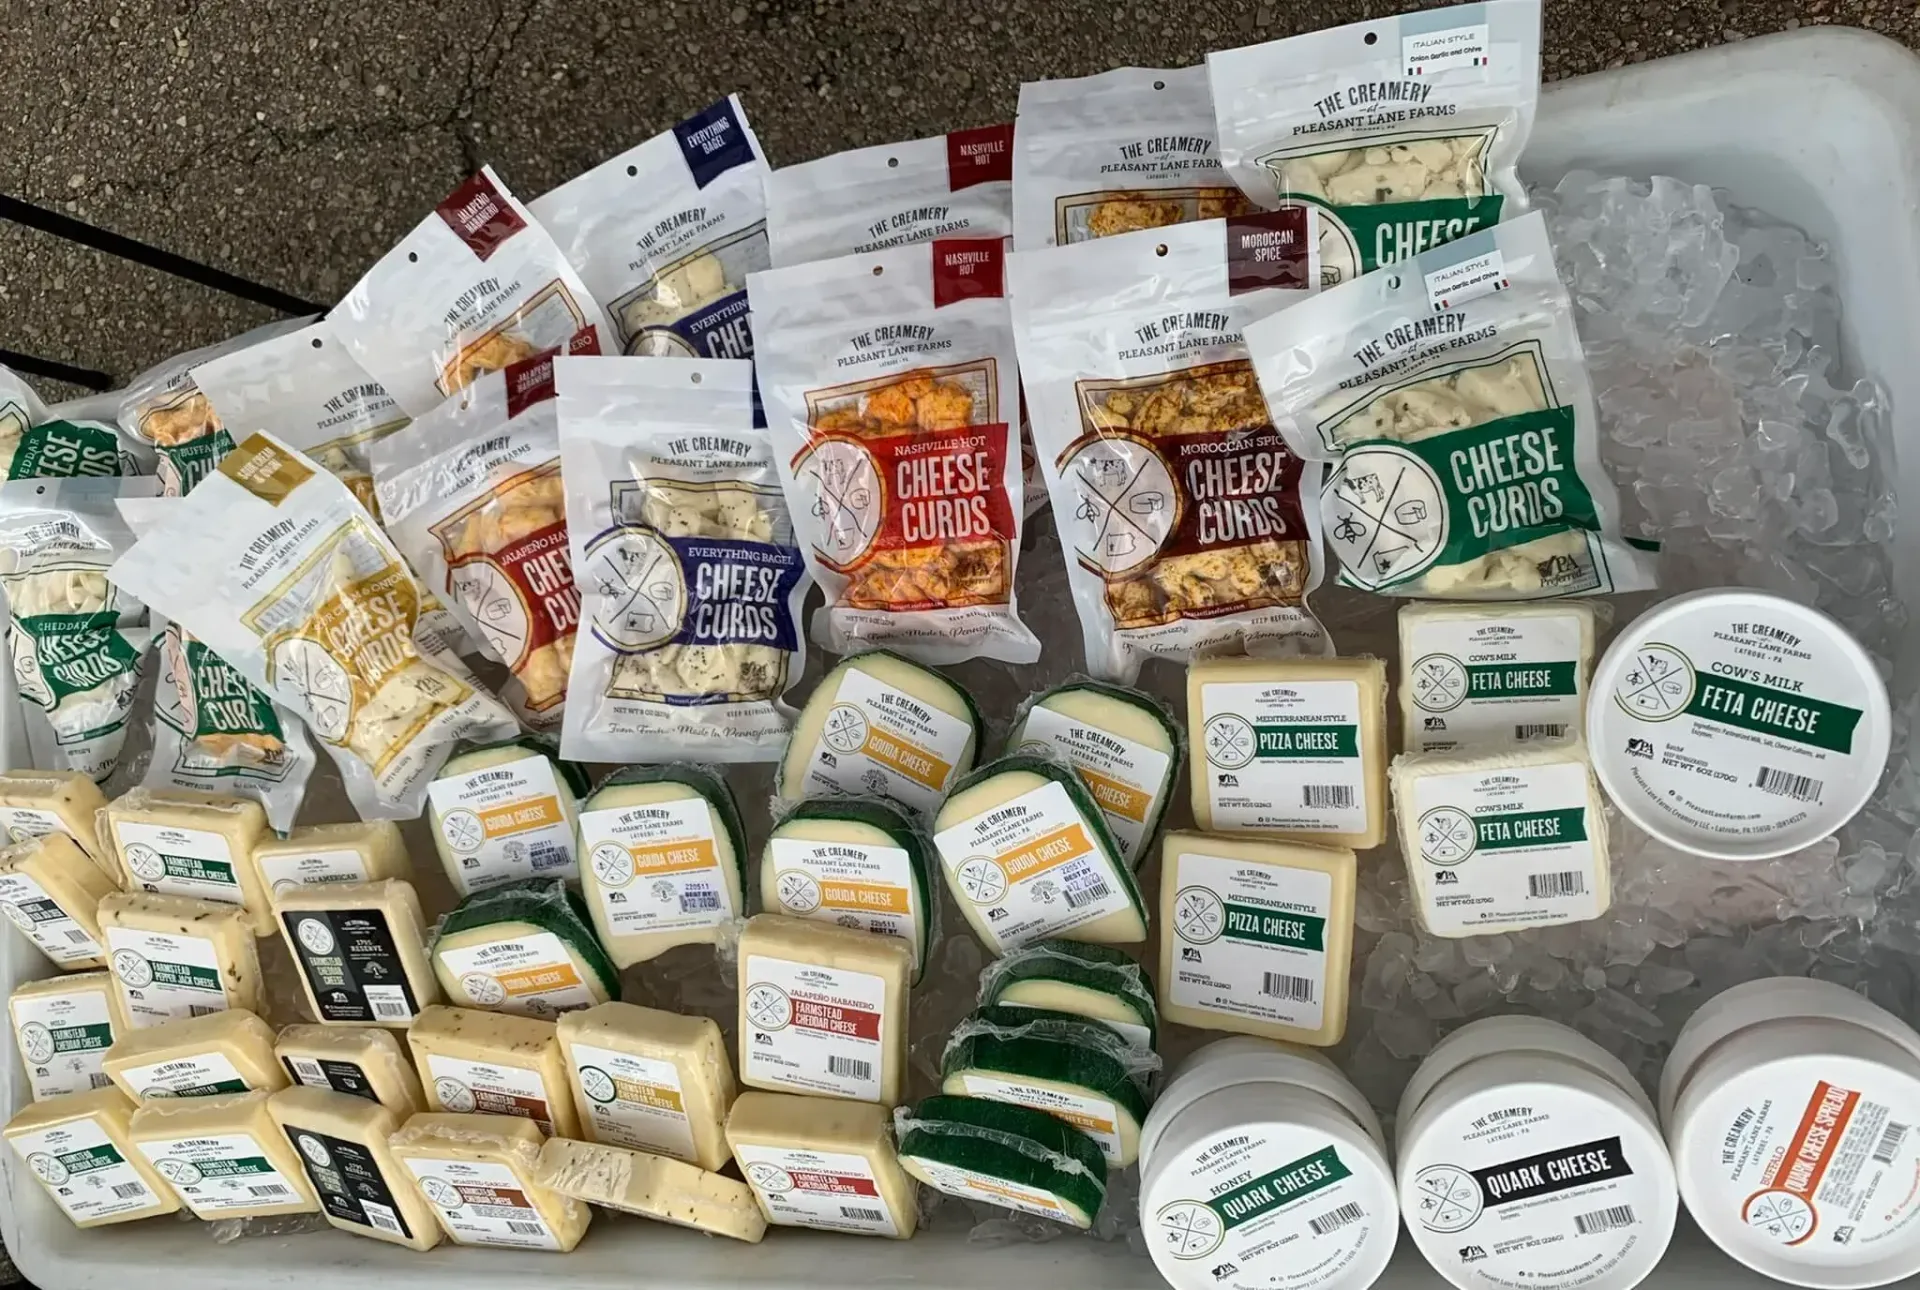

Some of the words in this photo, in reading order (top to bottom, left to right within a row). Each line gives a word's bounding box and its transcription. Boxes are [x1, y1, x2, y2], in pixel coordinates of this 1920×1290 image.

[1412, 36, 1447, 49] ITALIAN
[1448, 32, 1475, 44] STYLE
[1409, 54, 1430, 62] Onion
[1313, 95, 1344, 118] THE
[1348, 81, 1432, 106] CREAMERY
[686, 116, 730, 149] EVERYTHING
[1292, 116, 1364, 136] PLEASANT
[1368, 111, 1406, 126] LANE
[1409, 104, 1456, 120] FARMS
[701, 135, 726, 155] BAGEL
[960, 140, 1005, 156] NASHVILLE
[1120, 144, 1144, 161] THE
[1147, 136, 1212, 156] CREAMERY
[975, 154, 991, 165] HOT
[456, 192, 491, 224] JALAPEÑO
[464, 204, 499, 235] HABANERO
[637, 230, 656, 251] THE
[654, 206, 707, 239] CREAMERY
[869, 219, 888, 239] THE
[890, 206, 949, 229] CREAMERY
[1241, 229, 1294, 249] MOROCCAN
[945, 251, 990, 267] NASHVILLE
[1255, 247, 1281, 262] SPICE
[959, 262, 975, 276] HOT
[1433, 269, 1462, 283] ITALIAN
[1463, 258, 1491, 274] STYLE
[851, 332, 871, 351] THE
[874, 325, 935, 347] CREAMERY
[1134, 323, 1158, 344] THE
[1161, 312, 1229, 334] CREAMERY
[1354, 339, 1383, 369] THE
[1385, 312, 1467, 351] CREAMERY
[838, 351, 886, 368] PLEASANT
[888, 345, 916, 357] LANE
[917, 339, 952, 352] FARMS
[1338, 359, 1409, 391] PLEASANT
[1411, 342, 1448, 367] LANE
[1450, 325, 1497, 350] FARMS
[668, 441, 689, 456] THE
[691, 436, 752, 458] CREAMERY
[894, 438, 959, 456] NASHVILLE
[960, 436, 986, 449] HOT
[1180, 438, 1254, 456] MOROCCAN
[1257, 436, 1284, 448] SPIC
[1450, 427, 1564, 494] CHEESE
[897, 451, 991, 500] CHEESE
[1186, 451, 1283, 501] CHEESE
[901, 494, 991, 544] CURDS
[1199, 496, 1288, 544] CURDS
[1468, 478, 1564, 539] CURDS
[240, 553, 254, 570] THE
[250, 518, 297, 555] CREAMERY
[501, 531, 549, 567] JALAPEÑO
[688, 547, 760, 562] EVERYTHING
[761, 554, 794, 566] BAGEL
[696, 562, 785, 604] CHEESE
[38, 622, 89, 631] CHEDDAR
[699, 601, 778, 642] CURDS
[1732, 623, 1749, 634] THE
[1752, 624, 1801, 648] CREAMERY
[53, 645, 123, 687] CURDS
[1469, 653, 1495, 662] COW'S
[1496, 653, 1517, 661] MILK
[1472, 672, 1501, 690] FETA
[1506, 670, 1552, 689] CHEESE
[1712, 661, 1760, 682] COW'S
[1764, 673, 1804, 692] MILK
[866, 699, 899, 720] PLEASANT
[898, 714, 917, 727] LANE
[915, 722, 938, 737] FARMS
[880, 693, 895, 704] THE
[896, 696, 932, 723] CREAMERY
[1256, 715, 1322, 723] MEDITERRANEAN
[1701, 684, 1743, 716] FETA
[1750, 697, 1821, 734] CHEESE
[1070, 728, 1085, 739] THE
[1086, 732, 1127, 756] CREAMERY
[1260, 733, 1292, 750] PIZZA
[1295, 733, 1339, 750] CHEESE
[869, 735, 899, 761] GOUDA
[900, 752, 934, 778] CHEESE
[1662, 757, 1680, 769] NET
[1680, 761, 1694, 772] WT
[1096, 784, 1131, 809] CHEESE
[1475, 804, 1502, 813] COW'S
[619, 815, 632, 825] THE
[634, 808, 670, 820] CREAMERY
[974, 820, 991, 834] THE
[987, 806, 1027, 830] CREAMERY
[969, 828, 1004, 848] PLEASANT
[1004, 821, 1024, 834] LANE
[1022, 811, 1044, 825] FARMS
[1480, 822, 1511, 842] FETA
[1514, 817, 1561, 838] CHEESE
[164, 855, 203, 870] FARMSTEAD
[636, 852, 666, 868] GOUDA
[668, 848, 700, 864] CHEESE
[813, 848, 827, 858] THE
[828, 847, 868, 861] CREAMERY
[1004, 853, 1038, 875] GOUDA
[1038, 838, 1073, 862] CHEESE
[167, 865, 191, 878] PEPPER
[191, 868, 207, 879] JACK
[206, 869, 229, 882] CHEESE
[318, 873, 358, 883] AMERICAN
[1064, 872, 1080, 882] BEST
[1082, 867, 1091, 875] BY
[825, 888, 856, 902] GOUDA
[858, 890, 892, 906] CHEESE
[1228, 894, 1293, 910] MEDITERRANEAN
[1293, 905, 1317, 913] STYLE
[1228, 912, 1259, 933] PIZZA
[1263, 918, 1306, 940] CHEESE
[791, 990, 830, 1003] JALAPEÑO
[831, 997, 874, 1010] HABANERO
[795, 1002, 843, 1020] FARMSTEAD
[52, 1028, 86, 1039] FARMSTEAD
[795, 1014, 830, 1031] CHEDDAR
[830, 1019, 857, 1034] CHEESE
[56, 1038, 81, 1050] CHEDDAR
[82, 1036, 102, 1047] CHEESE
[1471, 1118, 1487, 1130] THE
[1487, 1107, 1533, 1123] CREAMERY
[1815, 1085, 1849, 1130] SPREAD
[1724, 1106, 1756, 1149] CREAMERY
[1196, 1151, 1209, 1164] THE
[1209, 1136, 1250, 1158] CREAMERY
[1797, 1123, 1832, 1162] CHEESE
[1723, 1150, 1735, 1165] THE
[1760, 1145, 1786, 1186] BUFFALO
[1210, 1171, 1254, 1196] HONEY
[1487, 1163, 1545, 1199] QUARK
[1546, 1149, 1612, 1183] CHEESE
[1784, 1158, 1816, 1193] QUARK
[1223, 1186, 1275, 1220] QUARK
[1274, 1159, 1332, 1196] CHEESE
